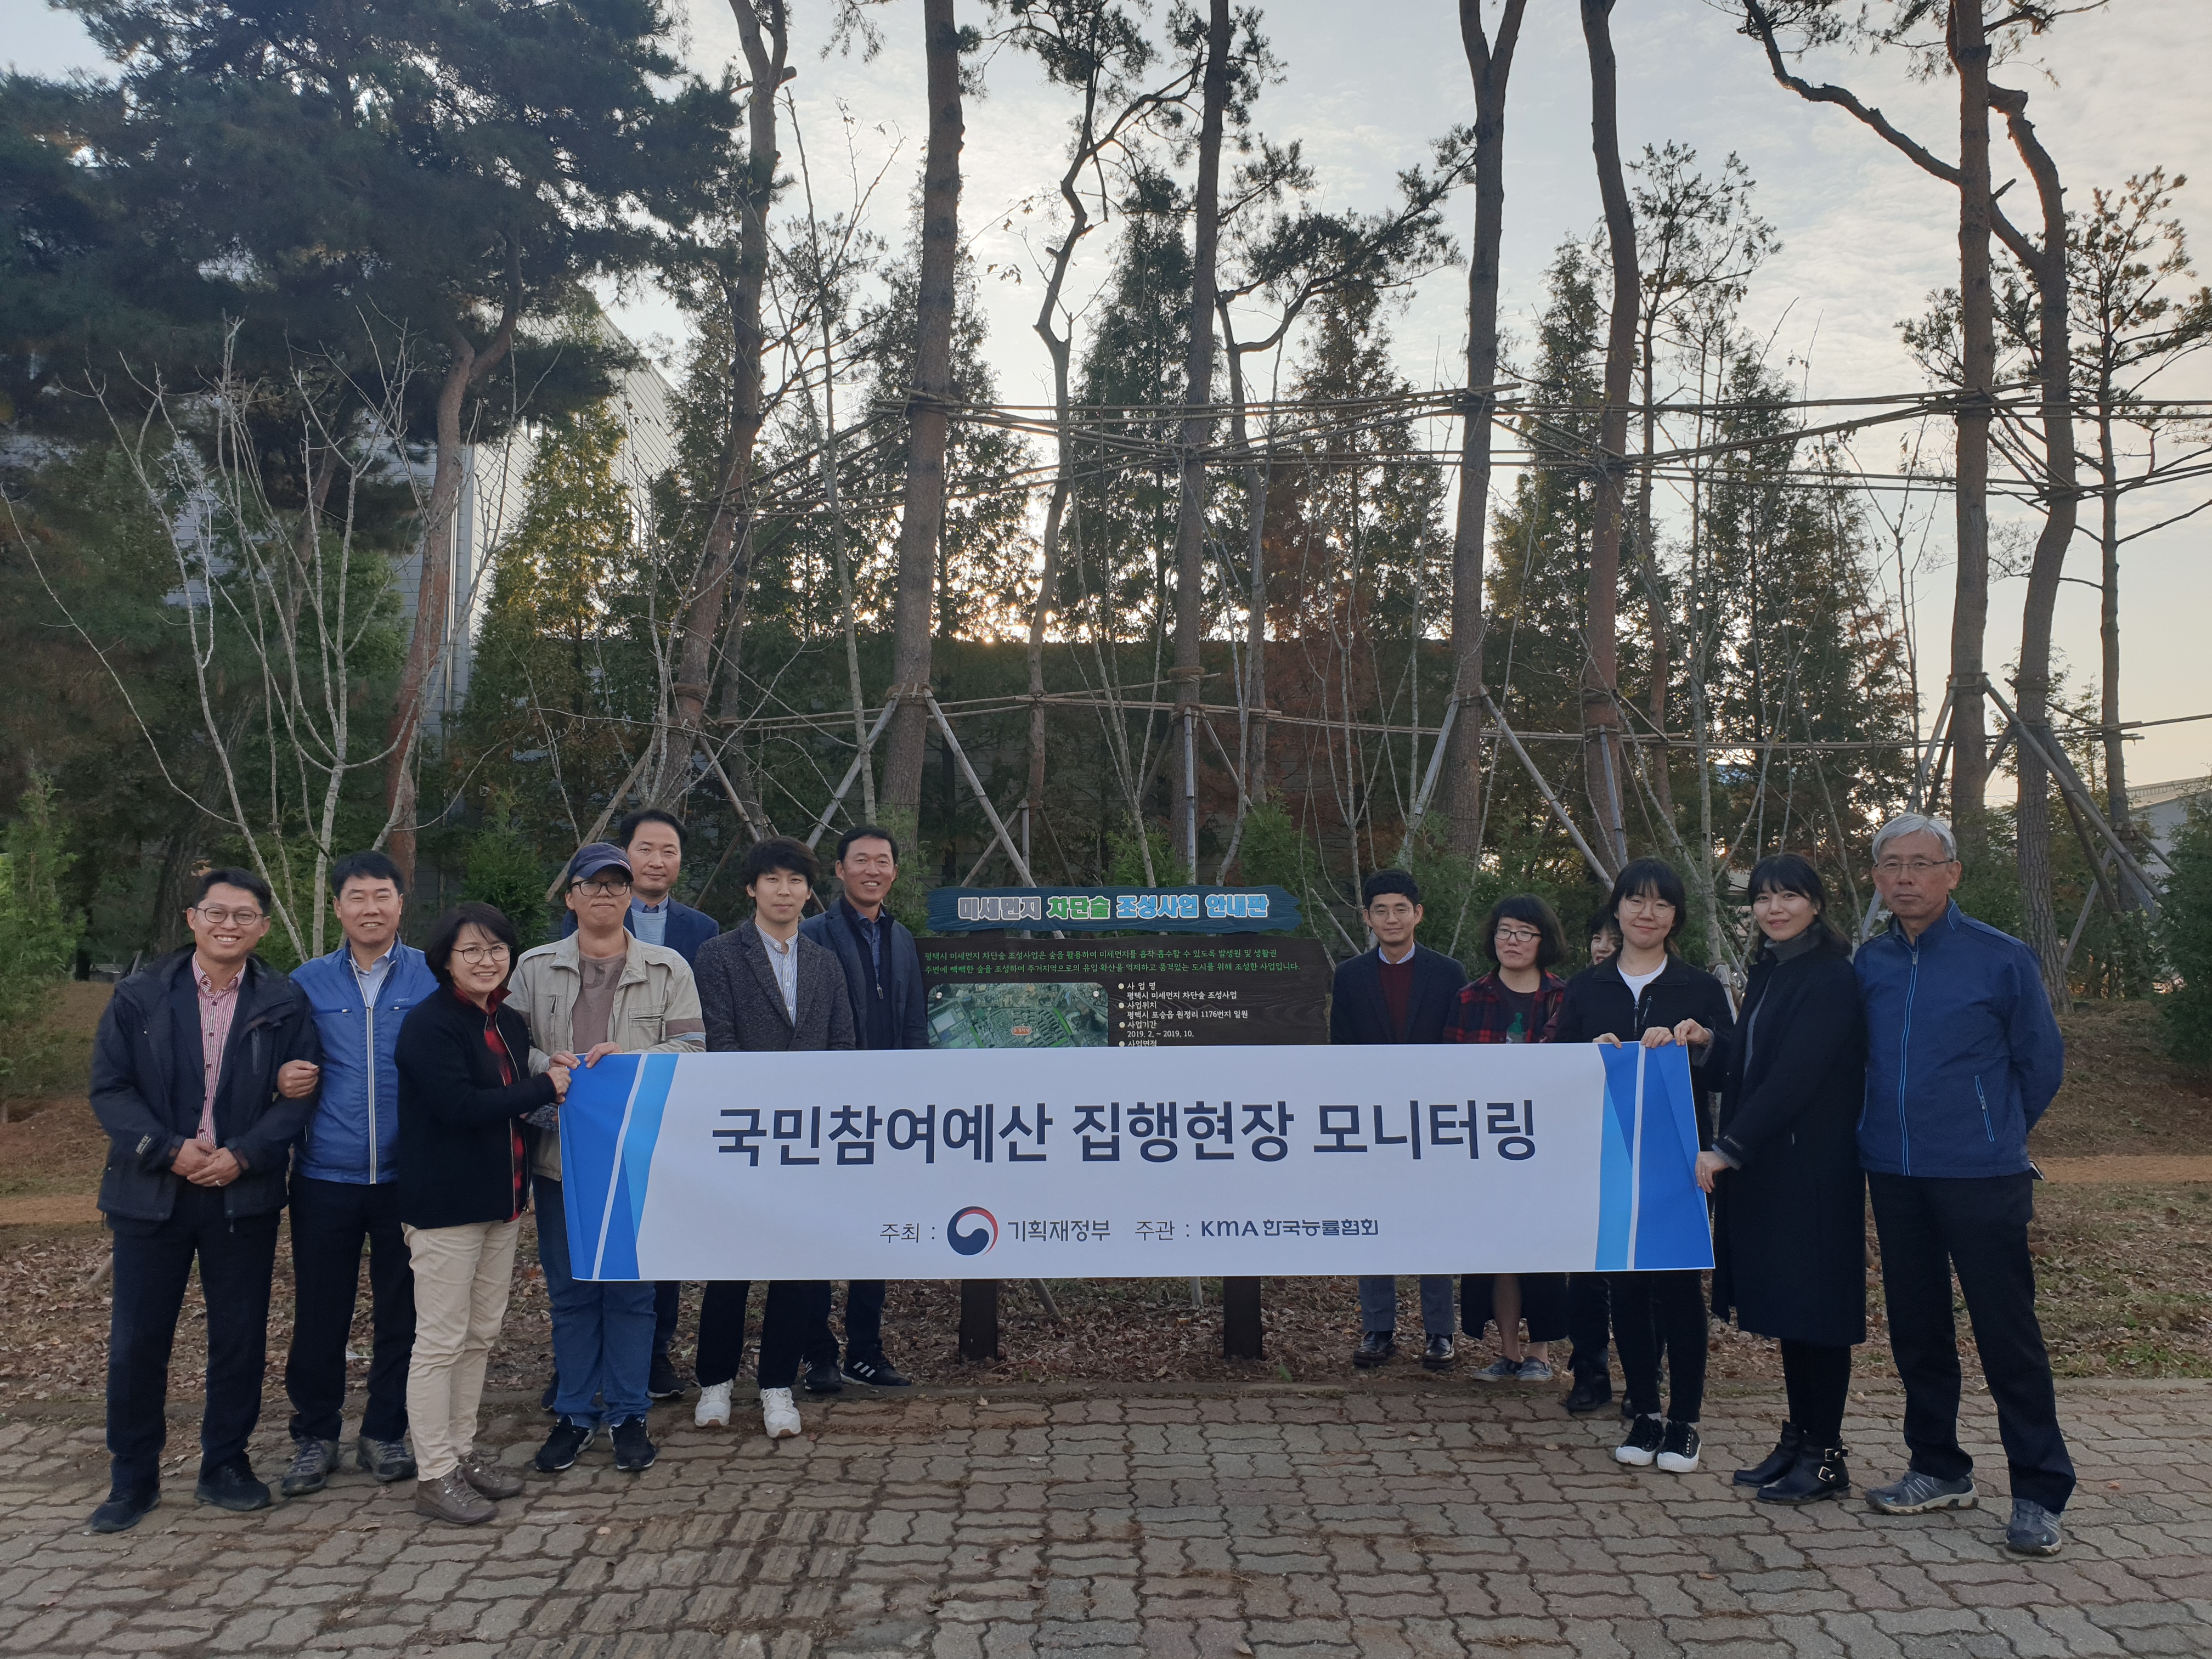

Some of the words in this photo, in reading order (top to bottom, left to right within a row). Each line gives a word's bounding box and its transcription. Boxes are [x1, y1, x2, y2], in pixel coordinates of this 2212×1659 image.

[958, 896, 1041, 921] 미세먼지
[1047, 895, 1111, 919] 차단숲
[1116, 895, 1199, 919] 조성사업
[1205, 894, 1269, 918] 안내판
[925, 952, 947, 961] 평택시
[950, 951, 980, 961] 미세먼지
[982, 951, 1006, 960] 차단숲
[1008, 951, 1047, 960] 조성사업은
[1048, 950, 1064, 960] 숲을
[1066, 950, 1097, 960] 활용하여
[1099, 949, 1137, 959] 미세먼지를
[1182, 950, 1191, 958] 수
[1193, 949, 1216, 958] 있도록
[1218, 949, 1241, 958] 발생원
[1244, 949, 1251, 958] 및
[1254, 949, 1277, 958] 생활권
[924, 965, 947, 974] 주변에
[977, 964, 992, 974] 숲을
[994, 964, 1025, 973] 조성하여
[1027, 963, 1080, 973] 주거지역으로의
[1126, 963, 1157, 972] 억제하고
[1159, 962, 1189, 972] 품격있는
[1192, 962, 1215, 972] 도시를
[1216, 962, 1232, 971] 위해
[1234, 962, 1258, 971] 조성한
[1260, 962, 1300, 971] 사업입니다.
[1126, 991, 1148, 1000] 평택시
[1151, 991, 1180, 1000] 미세먼지
[1182, 991, 1206, 1000] 차단숲
[1207, 990, 1237, 1000] 조성사업
[1127, 1000, 1156, 1010] 사업위치
[1127, 1010, 1149, 1020] 평택시
[1151, 1010, 1175, 1019] 포승읍
[1176, 1009, 1198, 1019] 원정리
[1201, 1009, 1231, 1019] 1176번지
[1233, 1009, 1248, 1019] 일원
[1127, 1020, 1158, 1029] 사업기간
[712, 1103, 1053, 1167] 국민참여예산
[1072, 1101, 1295, 1163] 집행현장
[1313, 1099, 1536, 1161] 모니터링
[879, 1223, 919, 1244] 주최
[1008, 1220, 1110, 1242] 기획재정부
[1135, 1220, 1175, 1241] 주관
[1262, 1218, 1379, 1237] 한국능률협회
